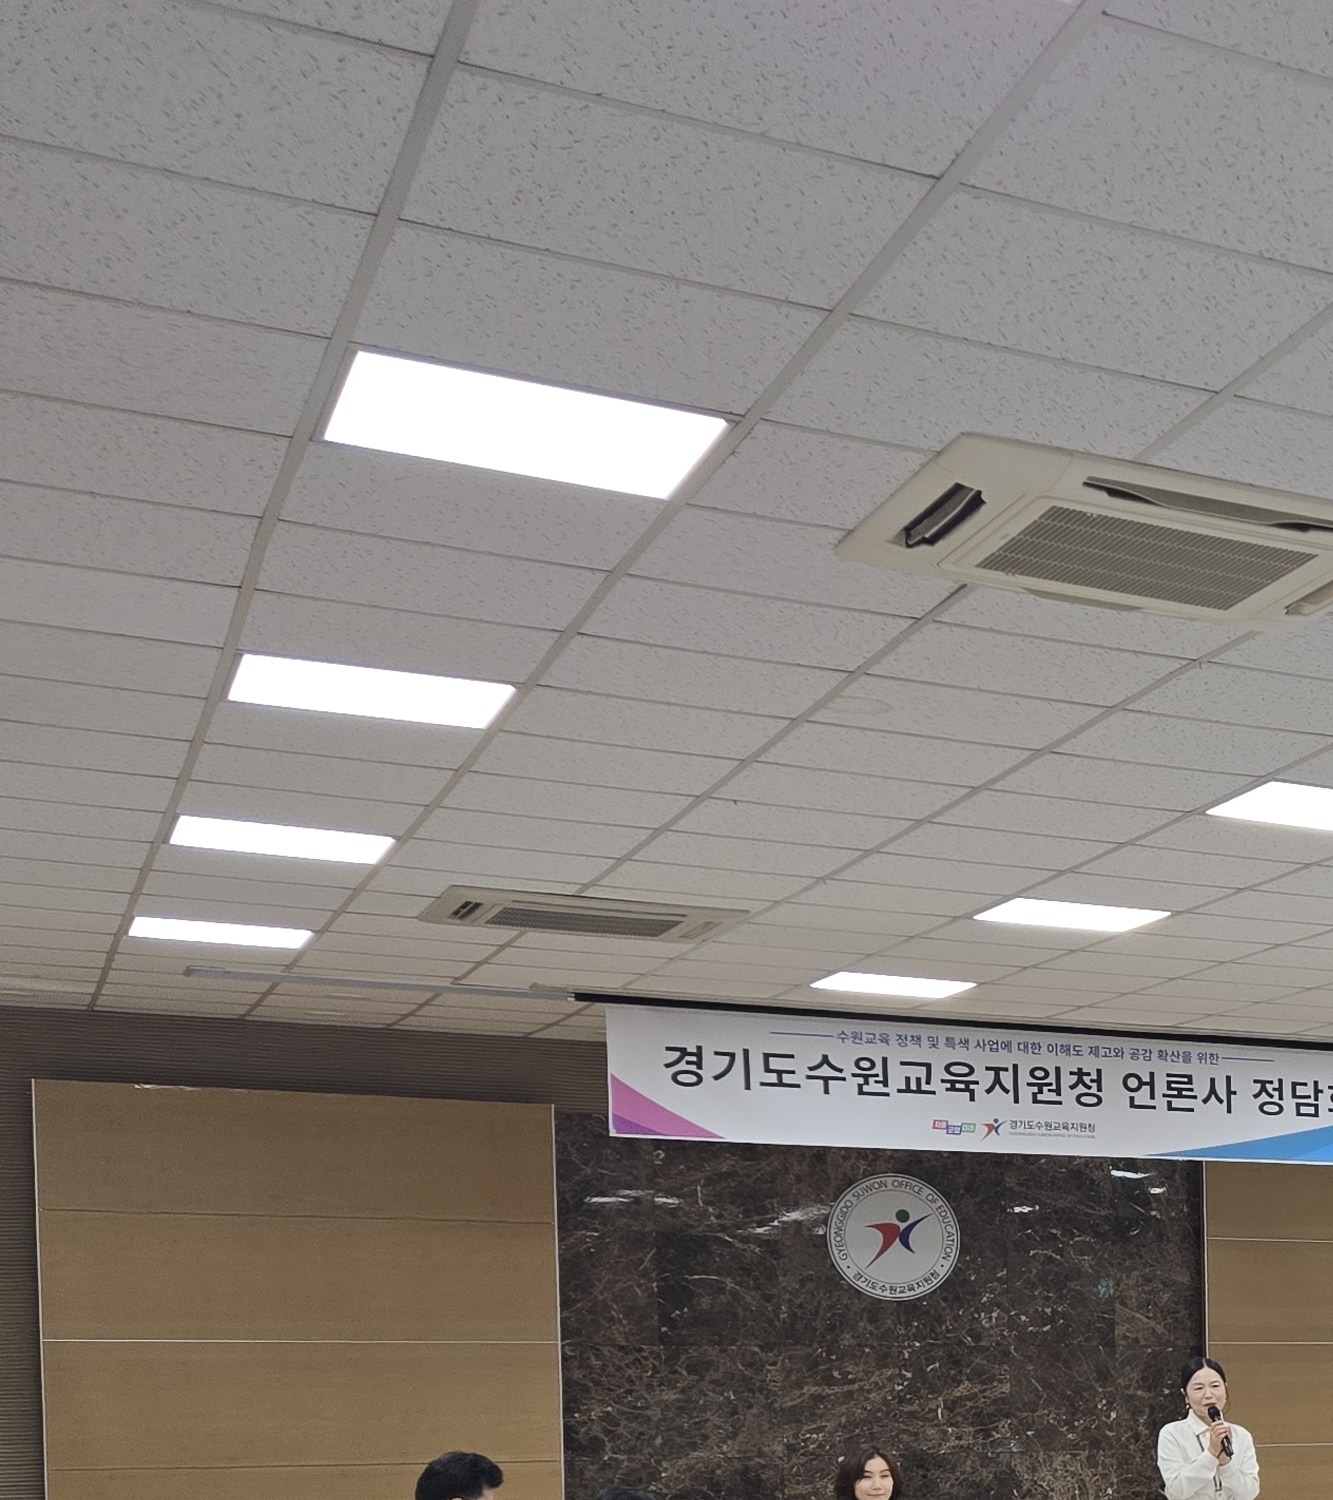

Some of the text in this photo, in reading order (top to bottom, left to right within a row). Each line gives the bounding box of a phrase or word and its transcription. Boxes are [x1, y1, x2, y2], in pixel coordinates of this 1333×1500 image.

[836, 1030, 1220, 1066] 수원교육 정책 및 특색 사업에 대한 이해도 제고와 공감 확산을 위한
[663, 1045, 1105, 1108] 경기도수원교육지원청
[1121, 1071, 1237, 1113] 언론사
[1008, 1119, 1096, 1134] 경기도수원교육지원청
[833, 1179, 955, 1262] GYEONGGIDO SUWON OFFICE OF EDUCATION
